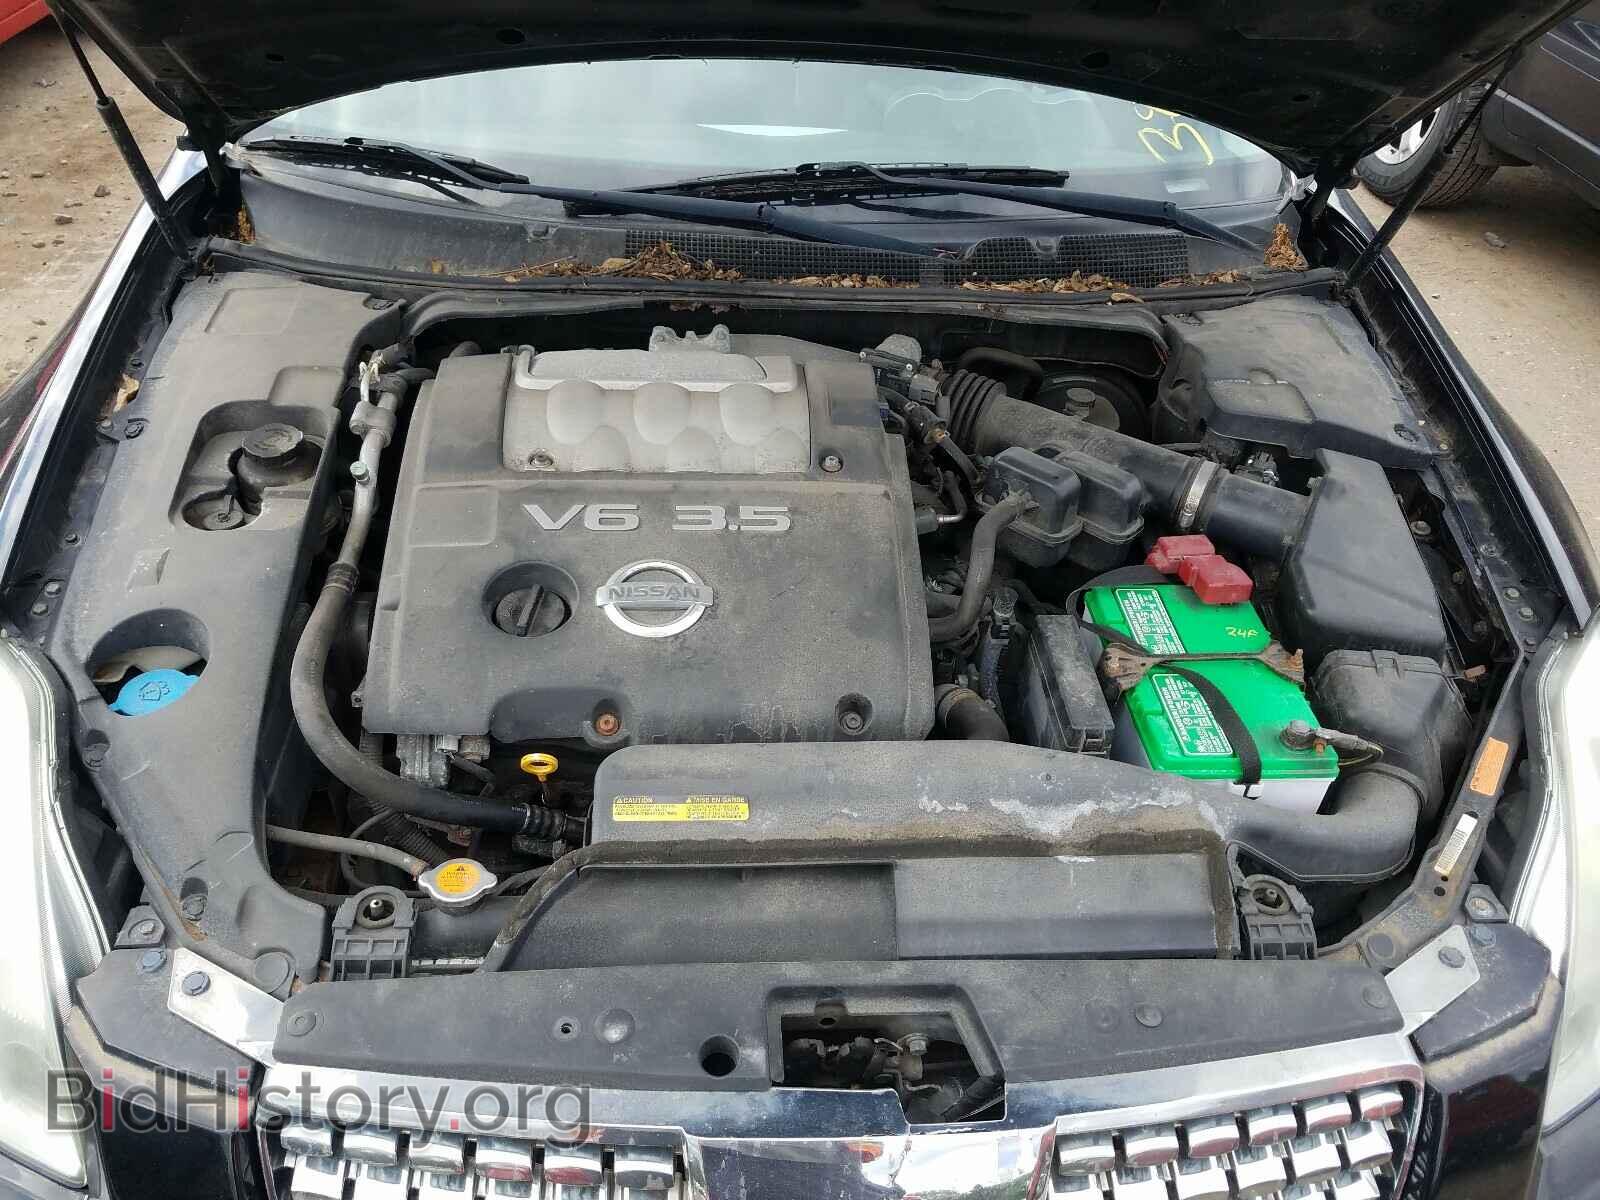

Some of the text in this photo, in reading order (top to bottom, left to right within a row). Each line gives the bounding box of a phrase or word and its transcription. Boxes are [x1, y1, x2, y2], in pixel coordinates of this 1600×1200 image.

[522, 504, 791, 531] V6 3.5
[608, 584, 700, 600] NISSAN
[623, 796, 654, 804] CAUTION
